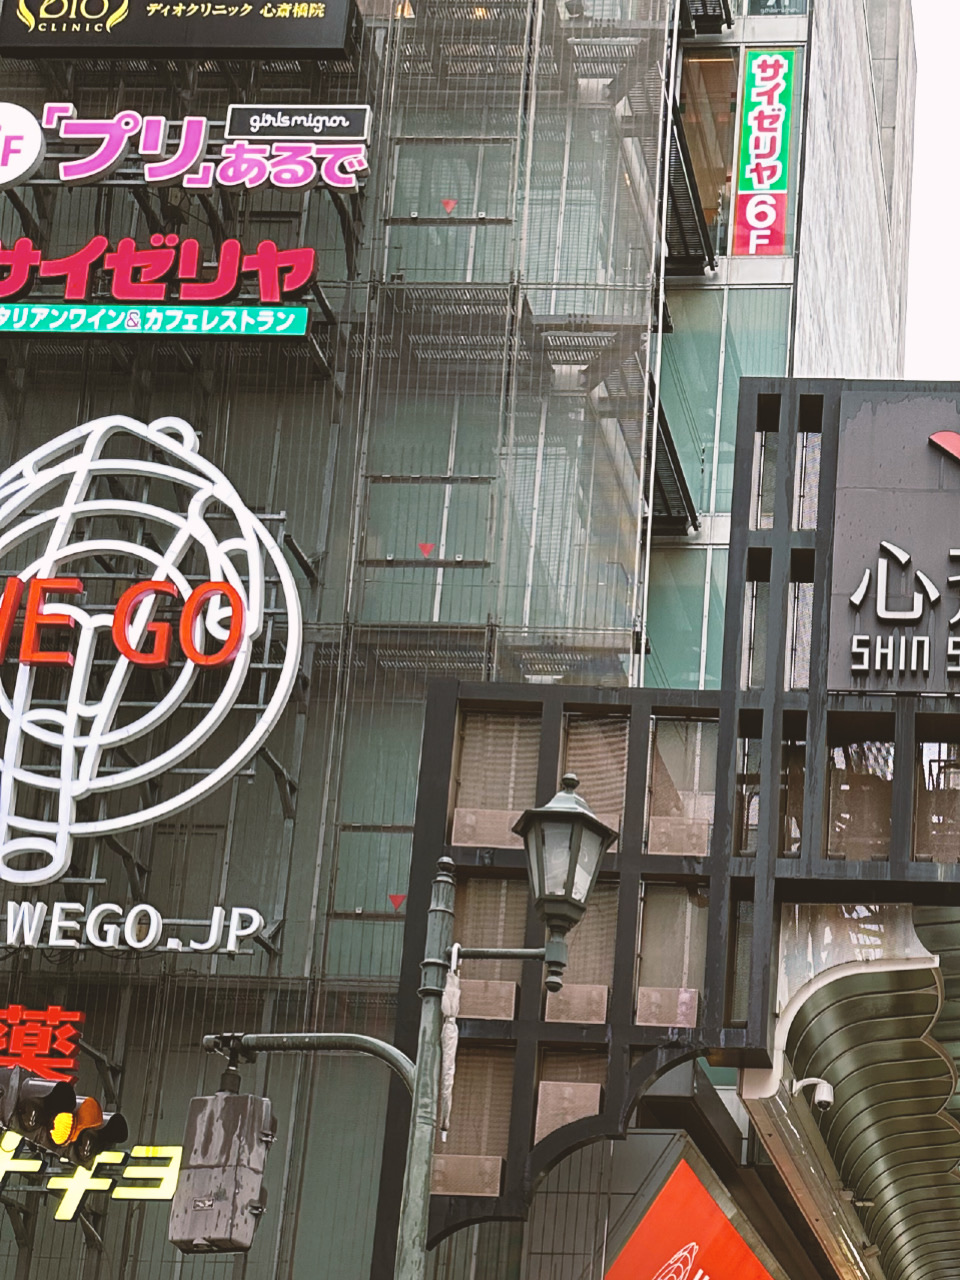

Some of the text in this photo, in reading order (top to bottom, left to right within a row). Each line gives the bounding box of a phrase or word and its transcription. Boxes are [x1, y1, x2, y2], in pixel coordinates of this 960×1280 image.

[38, 23, 104, 32] CLINIC
[146, 2, 253, 18] ディオクリニック
[747, 55, 787, 187] サイゼリヤ
[745, 195, 777, 254] 6F
[0, 233, 315, 302] サイゼリヤ
[0, 577, 245, 669] EGO
[850, 634, 931, 672] SHIN
[7, 901, 264, 952] WEGO.JP
[0, 1004, 83, 1084] 薬
